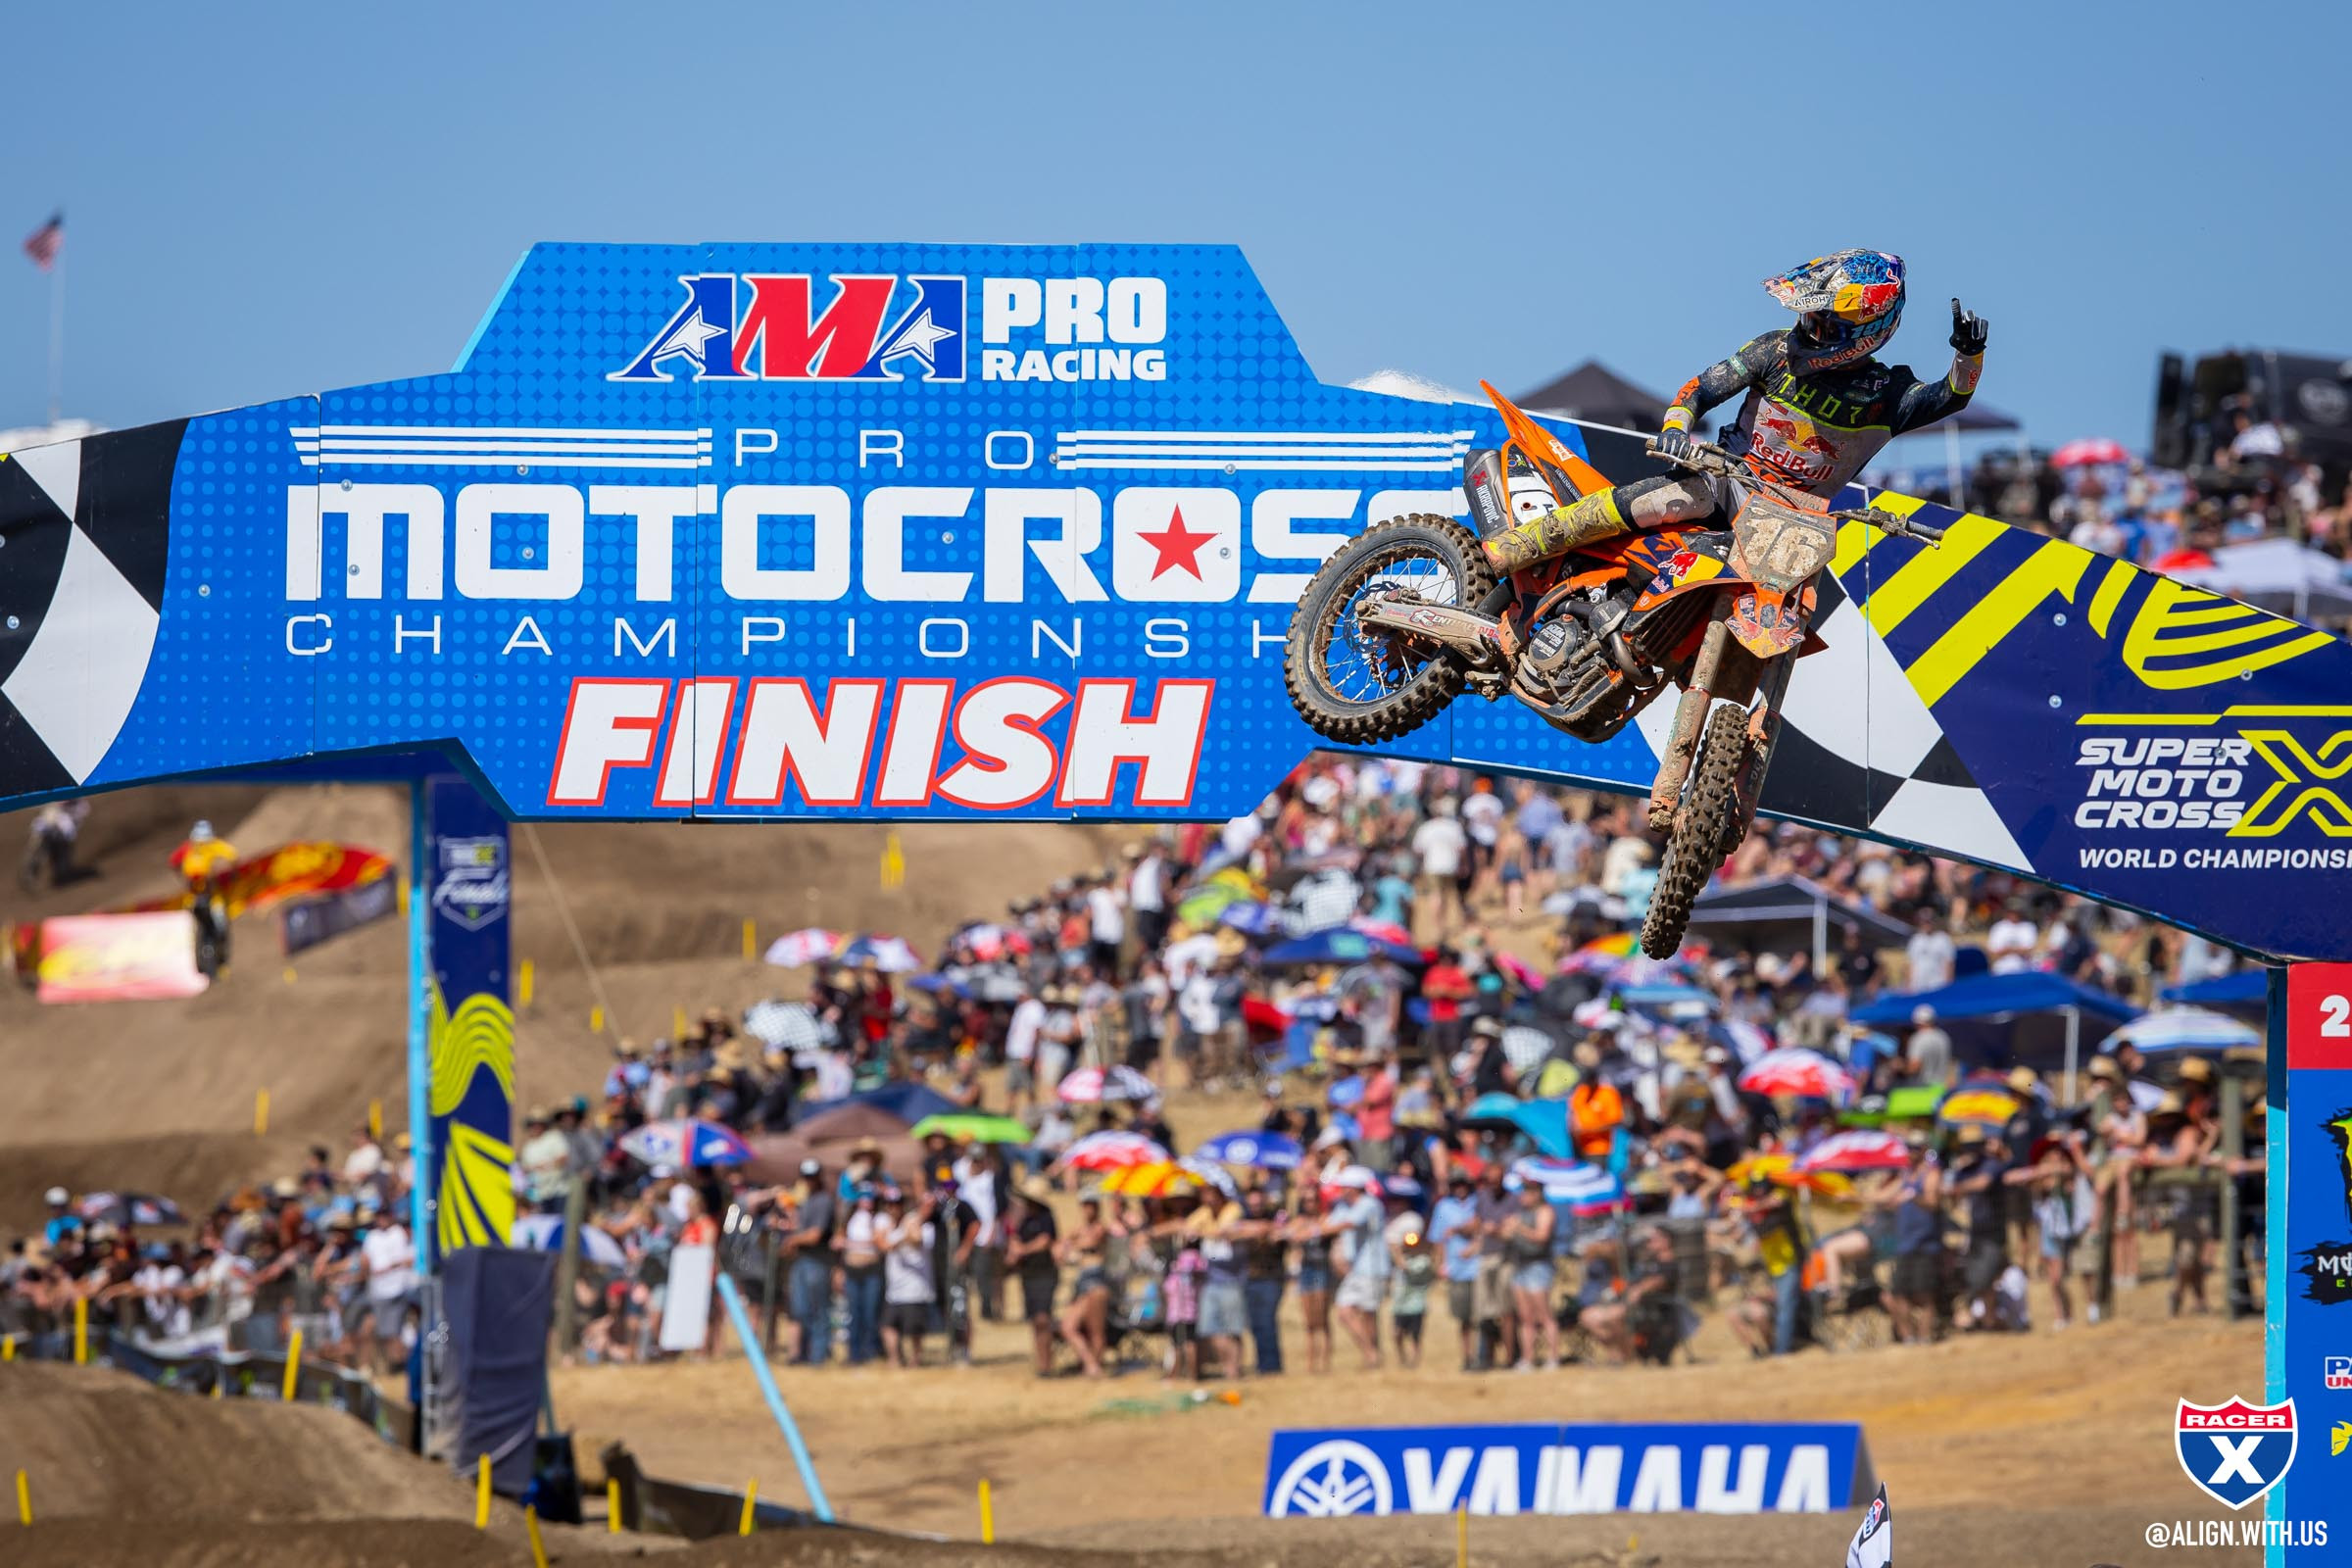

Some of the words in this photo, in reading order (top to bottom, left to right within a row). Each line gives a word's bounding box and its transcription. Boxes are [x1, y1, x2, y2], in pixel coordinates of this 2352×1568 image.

[607, 272, 967, 383] AMA
[981, 276, 1167, 344] PRO
[981, 349, 1167, 382] RACING
[1808, 351, 1841, 369] Red
[1841, 336, 1876, 359] Bull
[734, 428, 1035, 469] PRO
[1751, 429, 1790, 466] Red
[1788, 455, 1836, 482] Bull
[1745, 517, 1828, 578] 16
[285, 612, 1289, 660] CHAMPIONSH
[545, 675, 1216, 809] FINISH
[2075, 738, 2253, 765] SUPER
[2086, 769, 2243, 797] MOTO
[2075, 801, 2246, 829] CROSS
[2079, 849, 2178, 868] WORLD
[2320, 994, 2351, 1038] 2
[2327, 1358, 2352, 1375] P
[1401, 1445, 1831, 1514] YAMAHA
